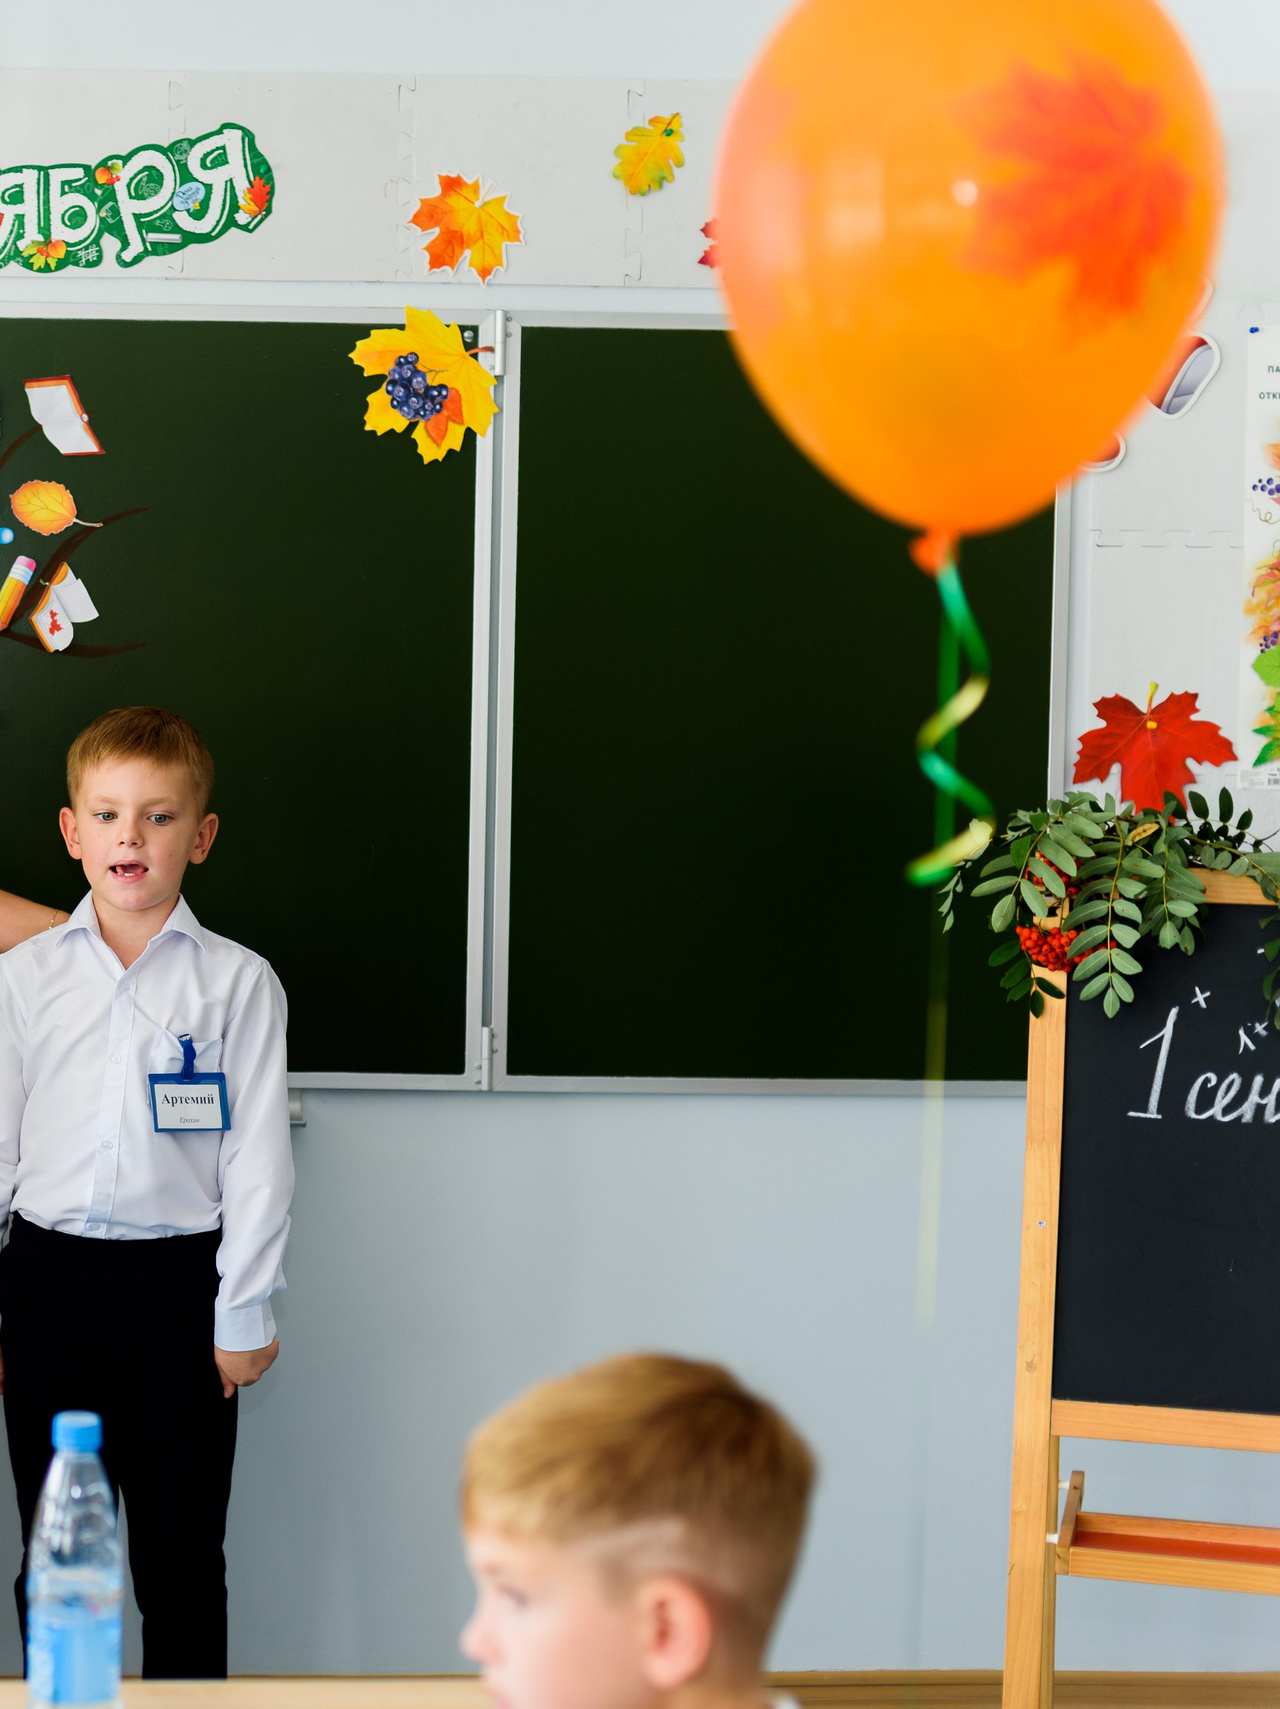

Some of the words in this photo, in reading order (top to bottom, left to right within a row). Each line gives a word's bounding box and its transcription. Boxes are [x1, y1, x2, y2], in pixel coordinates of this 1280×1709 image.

[1258, 391, 1280, 400] ОТК
[1126, 1005, 1180, 1120] 1
[1184, 1071, 1280, 1124] сен
[161, 1093, 215, 1107] Артемий
